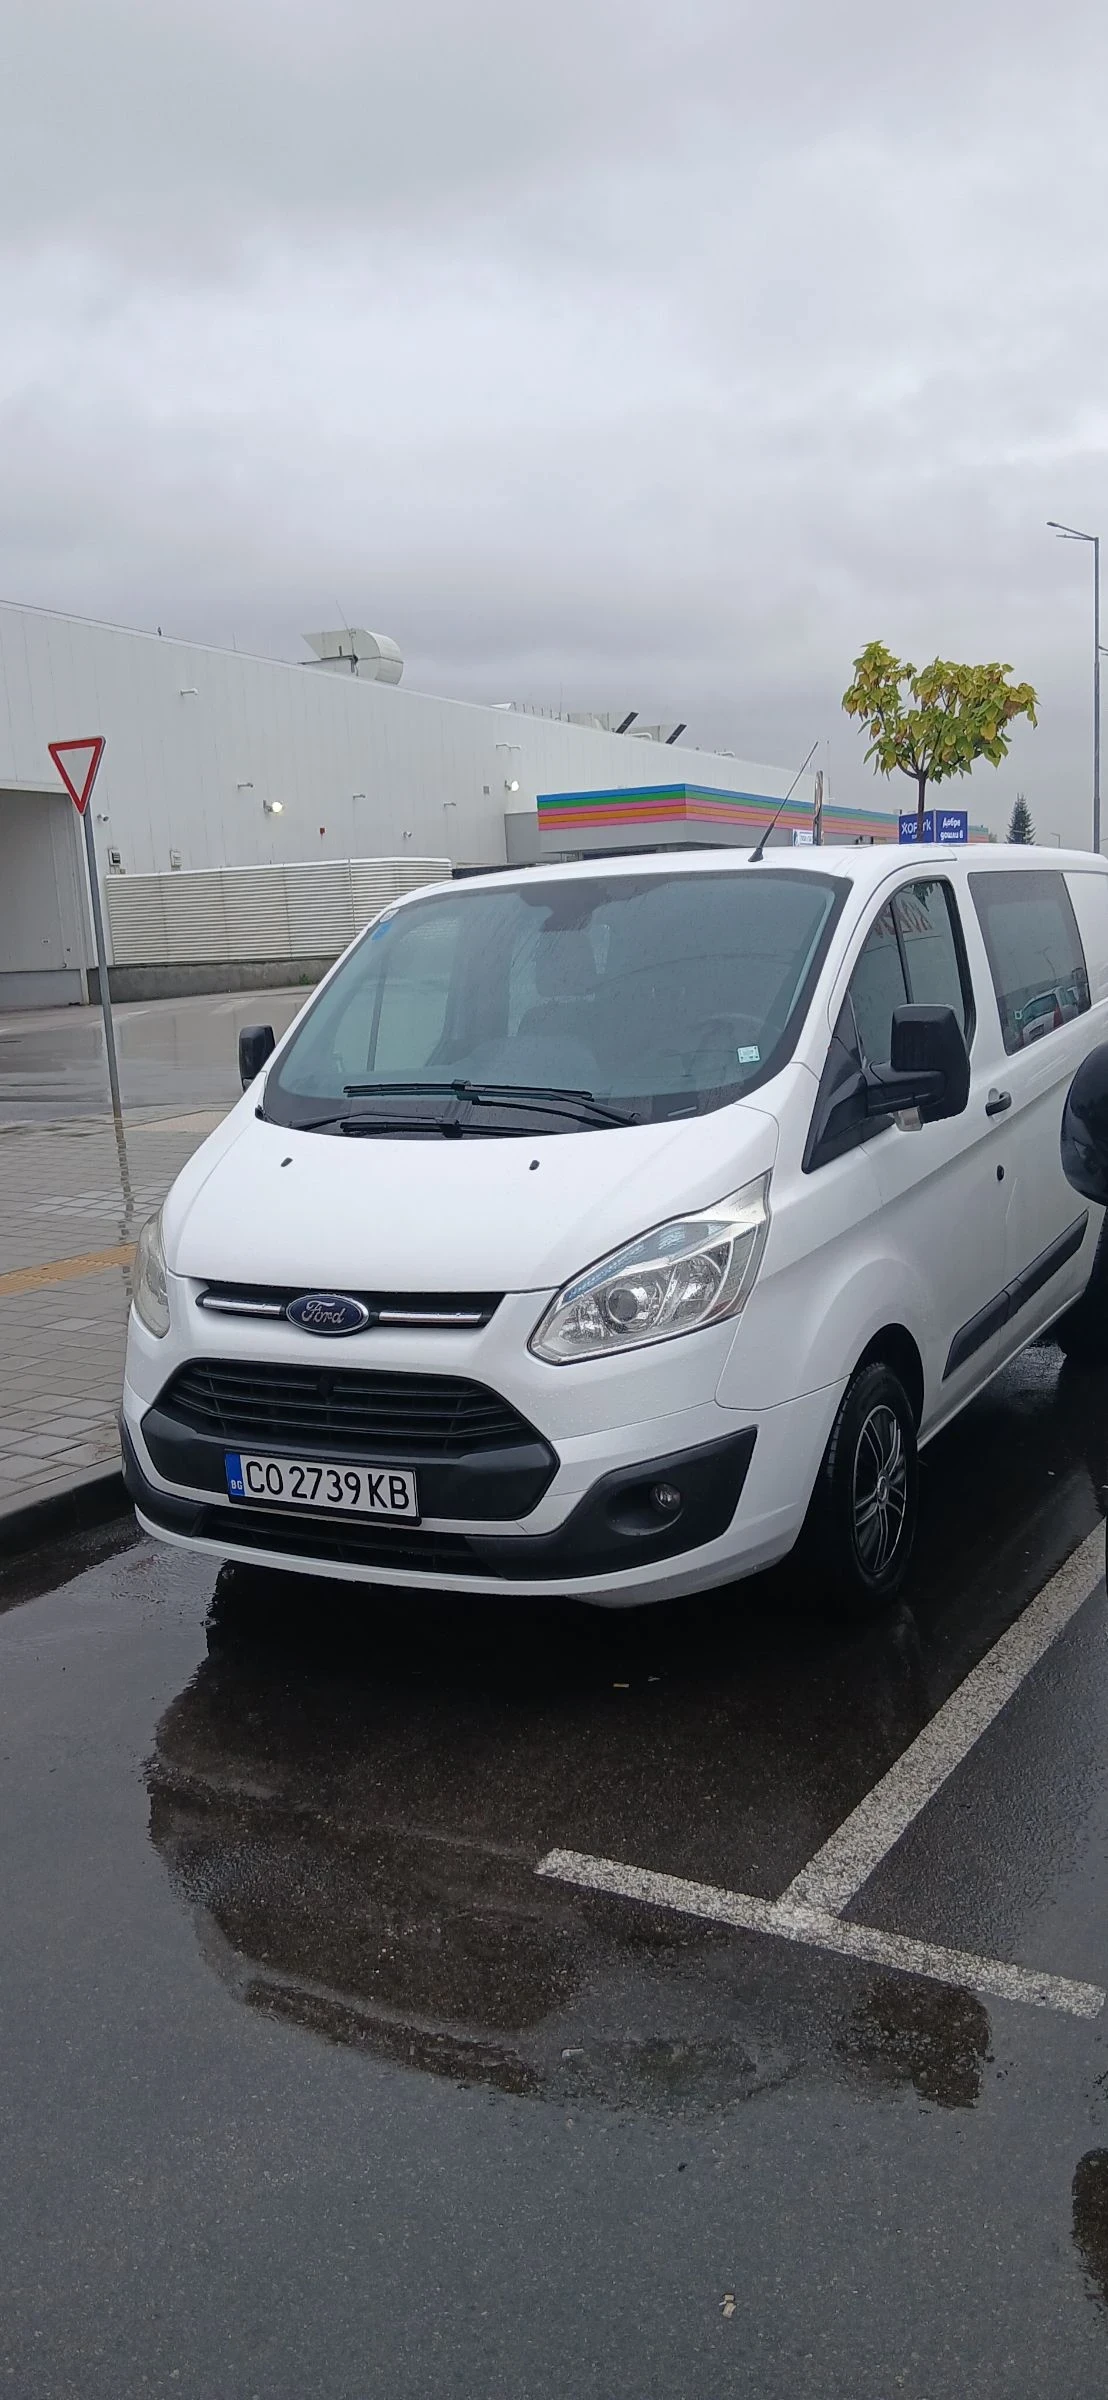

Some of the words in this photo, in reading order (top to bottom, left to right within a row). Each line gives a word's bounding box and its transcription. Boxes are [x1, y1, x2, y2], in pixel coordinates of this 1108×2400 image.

[901, 818, 932, 835] XOPrk
[301, 1300, 346, 1324] Ford
[230, 1479, 243, 1491] BG
[288, 1465, 361, 1505] 2739
[367, 1472, 410, 1510] KB
